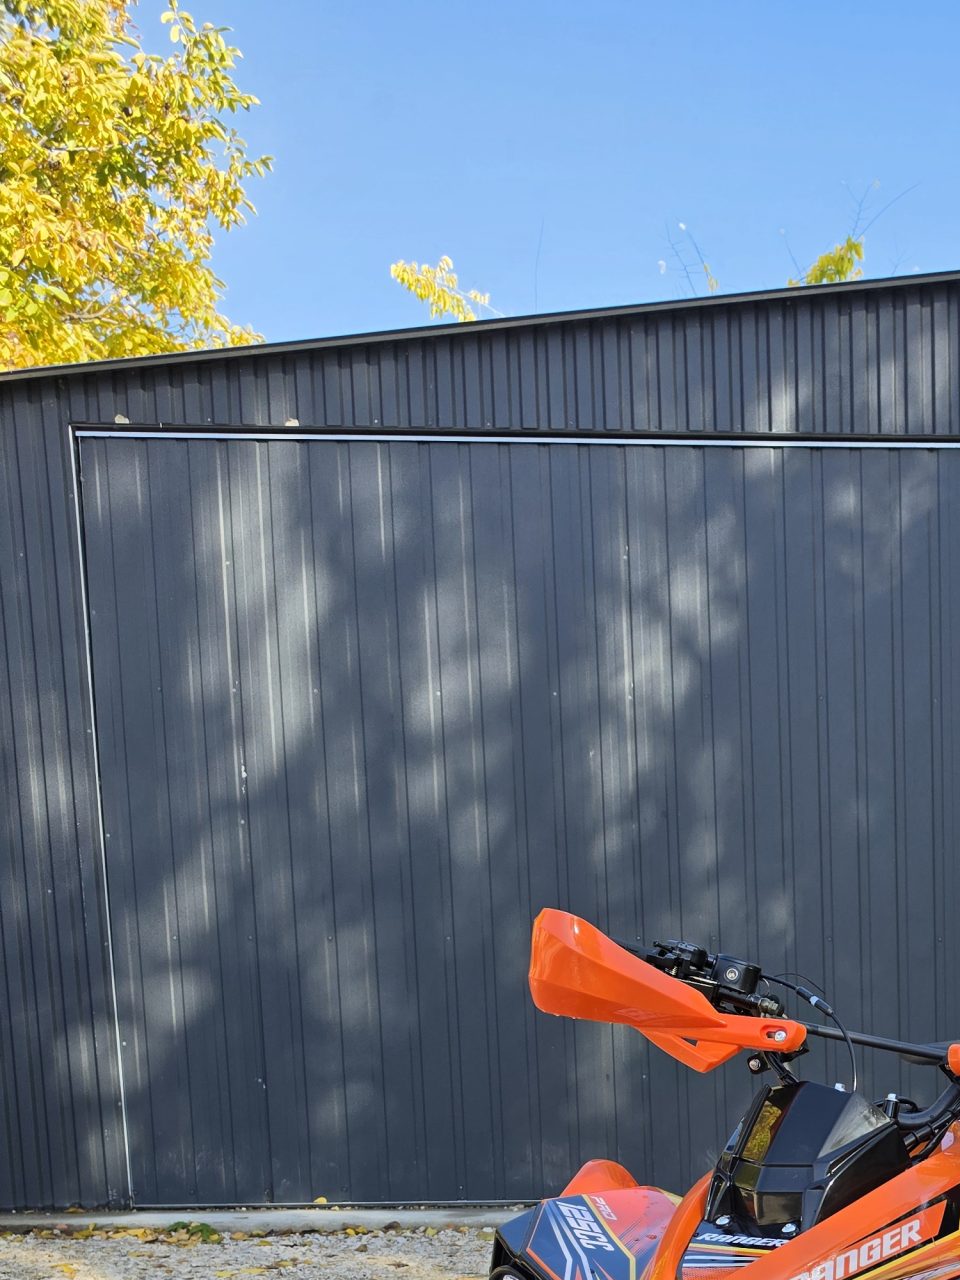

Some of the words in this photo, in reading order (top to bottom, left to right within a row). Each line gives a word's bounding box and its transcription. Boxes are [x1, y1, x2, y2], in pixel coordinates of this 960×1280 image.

[590, 1196, 618, 1220] PRO
[556, 1201, 615, 1252] 125CC
[696, 1232, 790, 1247] RANGER
